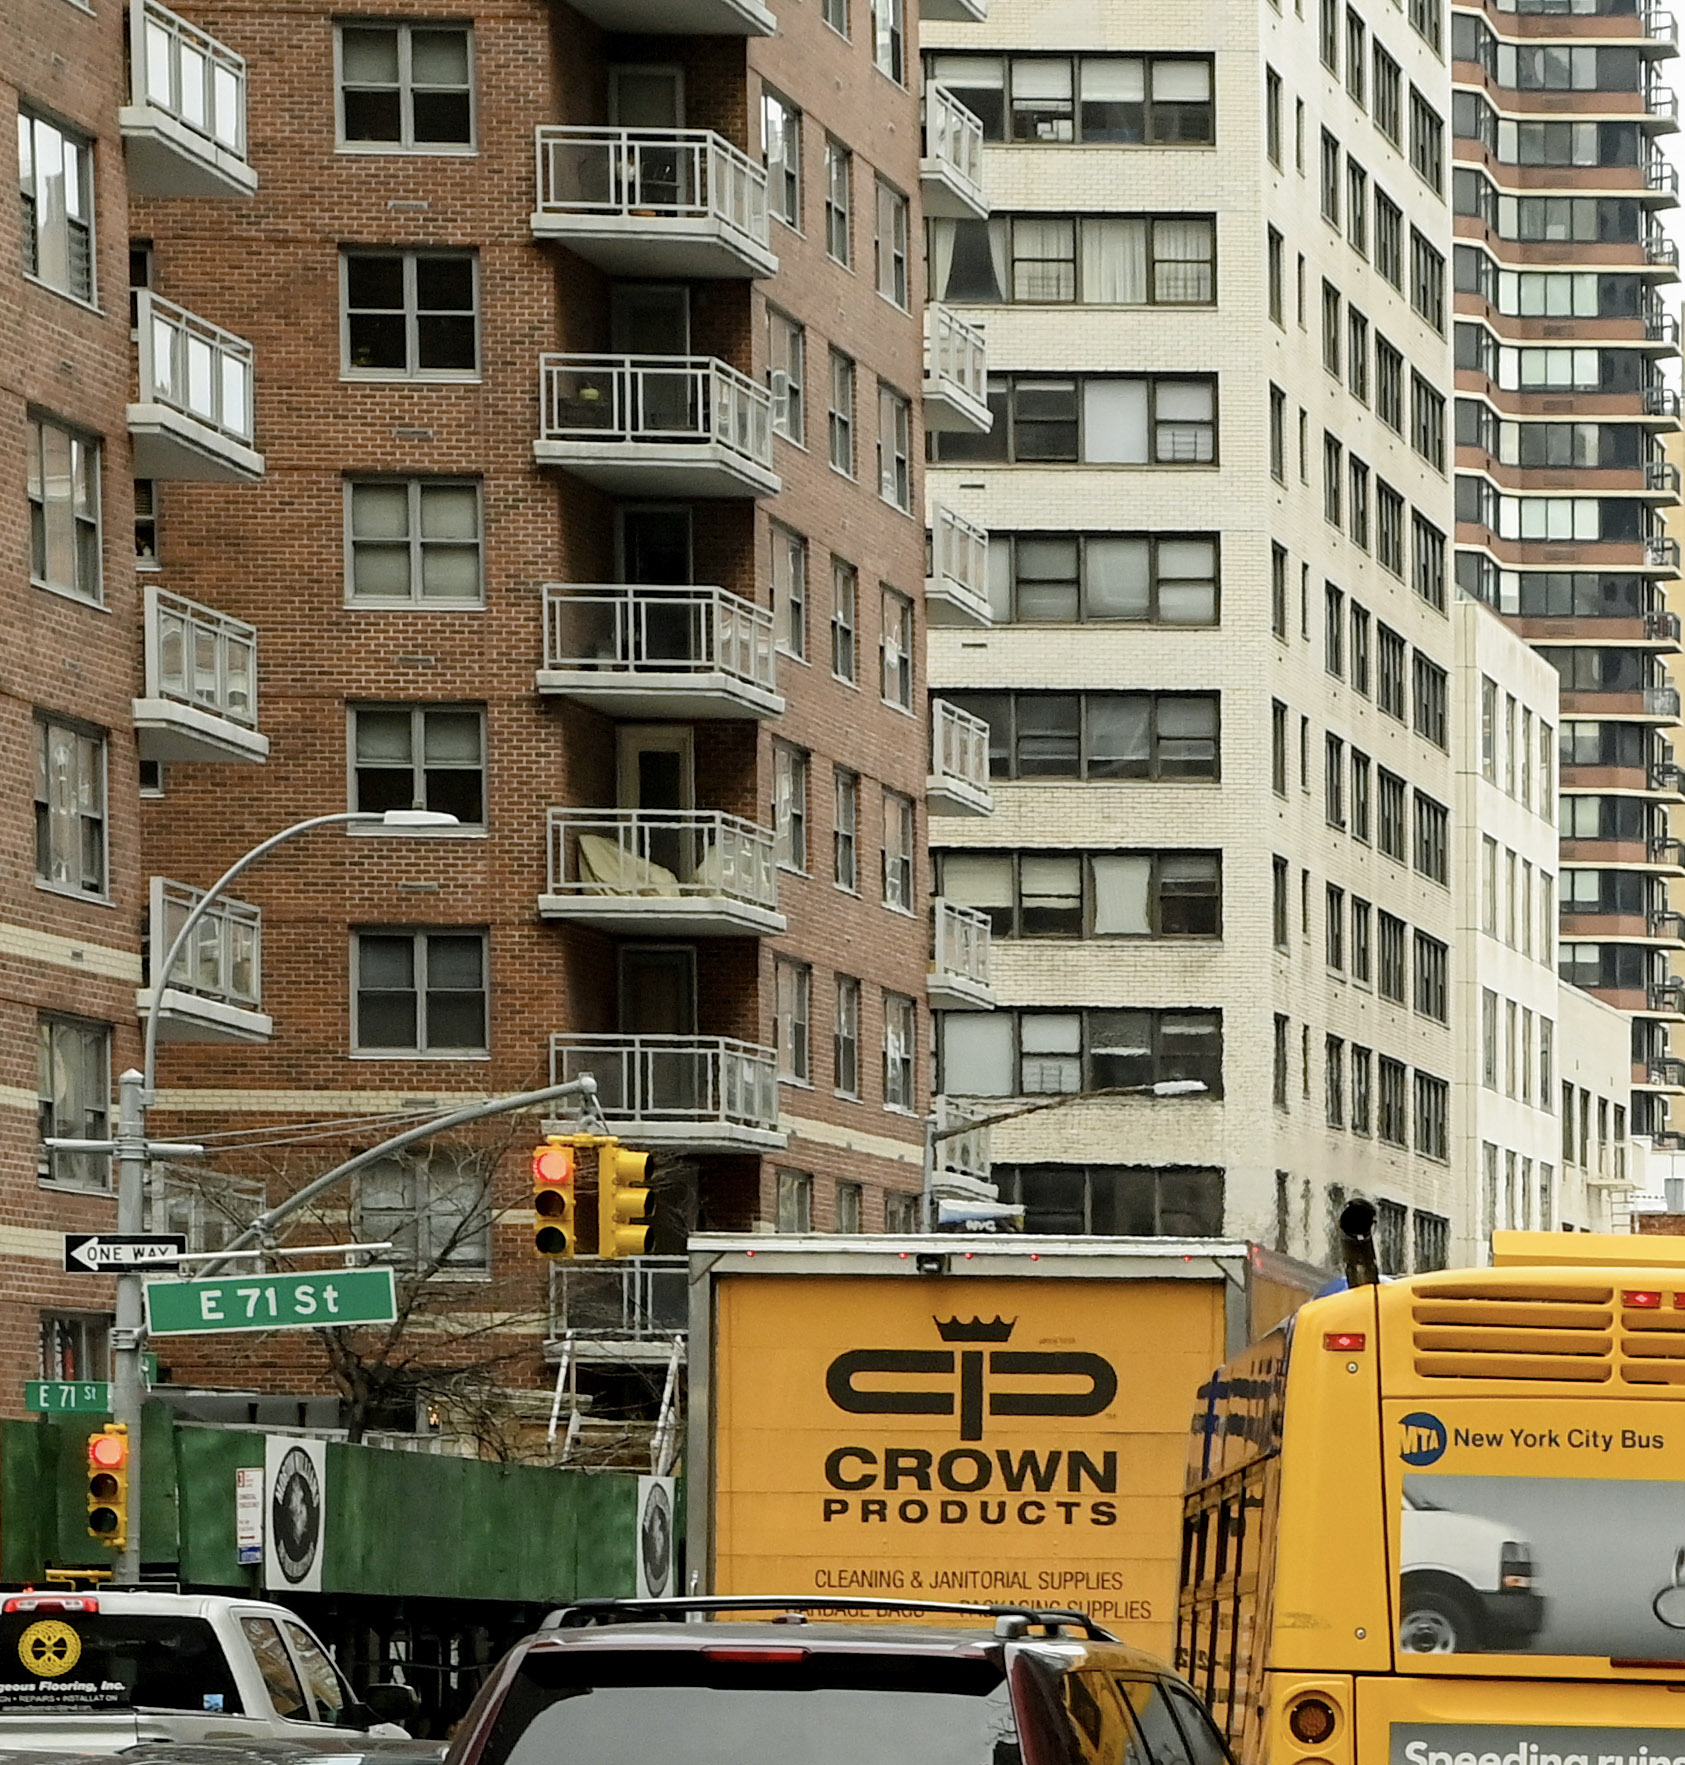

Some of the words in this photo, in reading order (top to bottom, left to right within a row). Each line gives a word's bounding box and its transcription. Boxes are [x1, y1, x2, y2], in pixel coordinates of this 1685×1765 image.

[86, 1246, 122, 1261] ONE
[133, 1247, 169, 1260] WAY
[200, 1290, 225, 1320] E
[237, 1287, 278, 1318] 71
[293, 1284, 339, 1315] St
[40, 1385, 49, 1407] E
[59, 1385, 75, 1407] 71
[84, 1385, 96, 1400] St
[1400, 1423, 1441, 1455] MTA
[1454, 1428, 1503, 1448] New
[1510, 1428, 1560, 1448] York
[1567, 1429, 1613, 1452] City
[1621, 1430, 1664, 1449] Bus
[824, 1447, 1119, 1493] CROWN
[823, 1499, 1118, 1526] PRODUCTS
[815, 1569, 904, 1589] CLEANING
[910, 1572, 923, 1589] &
[929, 1570, 1032, 1590] JANITORIAL
[1038, 1571, 1124, 1591] SUPPLIES
[38, 1680, 98, 1693] Flooring,
[100, 1680, 126, 1691] Inc.
